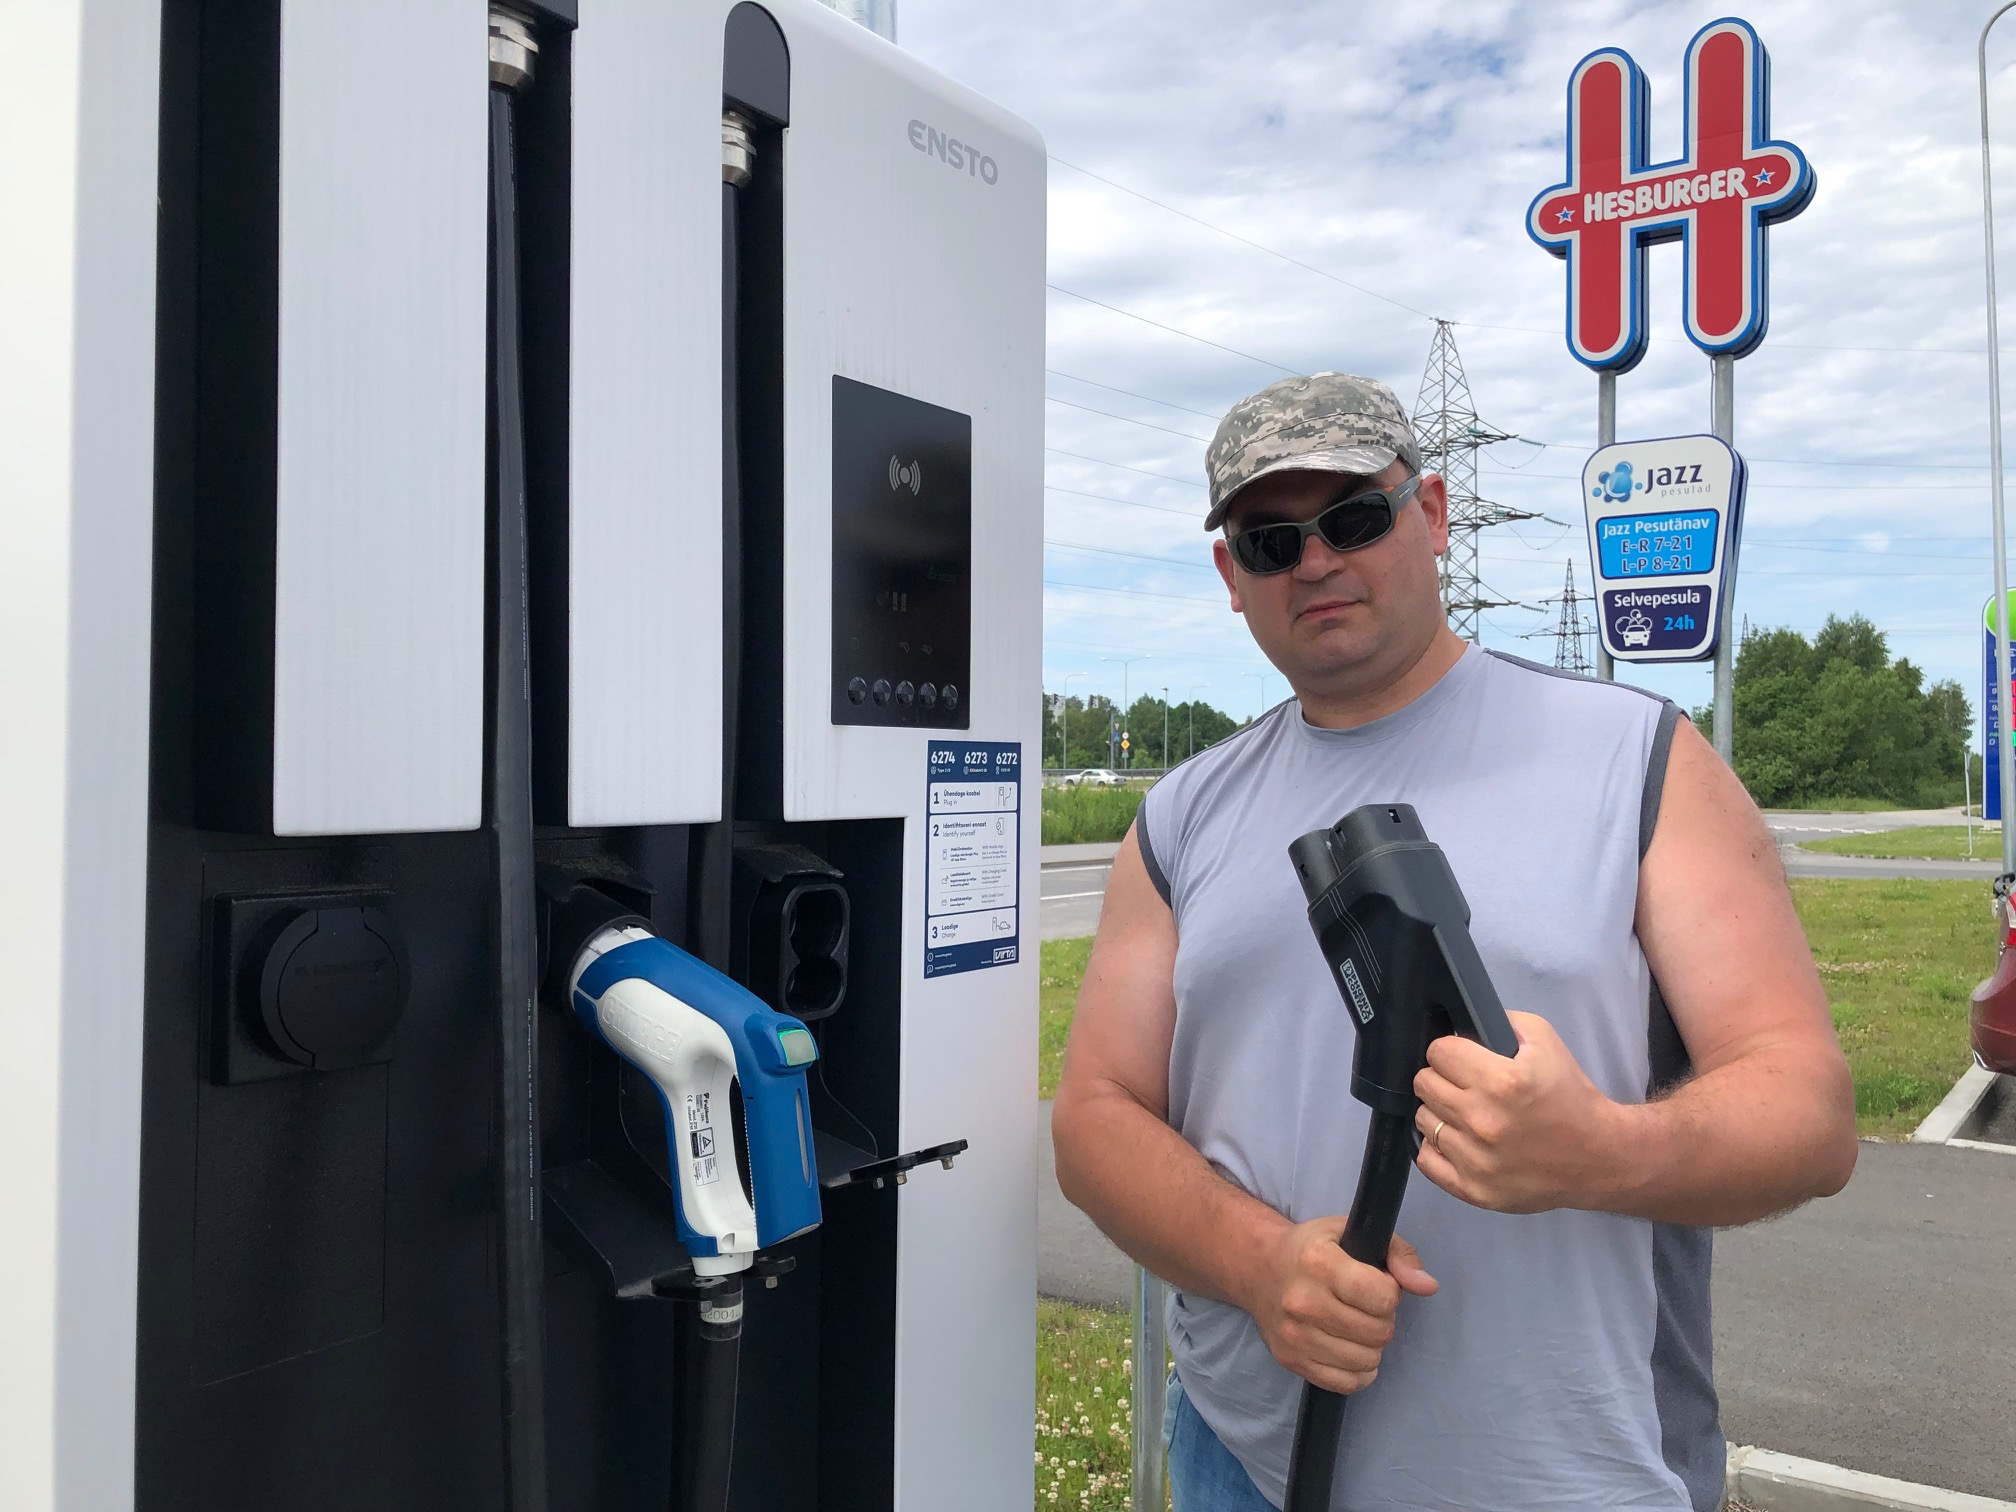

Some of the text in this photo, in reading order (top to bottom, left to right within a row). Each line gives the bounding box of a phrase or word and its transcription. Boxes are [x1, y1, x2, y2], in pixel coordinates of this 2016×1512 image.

[908, 119, 998, 186] ENSTO
[1583, 167, 1749, 224] HESBURGER
[1661, 483, 1711, 498] pesulad
[1603, 517, 1710, 539] Jazz Pesutänav
[1621, 535, 1692, 554] E-R 7-21
[1621, 555, 1692, 573] L-P 8-21
[1614, 589, 1701, 609] Selvepesula
[1664, 614, 1695, 631] 24h
[931, 751, 956, 764] 6274
[964, 752, 988, 765] 6273
[996, 752, 1018, 765] 6272
[933, 792, 940, 804] 1
[943, 799, 953, 807] Plug
[933, 824, 940, 837] 2
[943, 829, 976, 838] Identify yourself
[932, 926, 938, 939] 3
[941, 922, 959, 931] Laadige
[941, 931, 956, 939] Charge
[1347, 977, 1370, 1021] CONTACT
